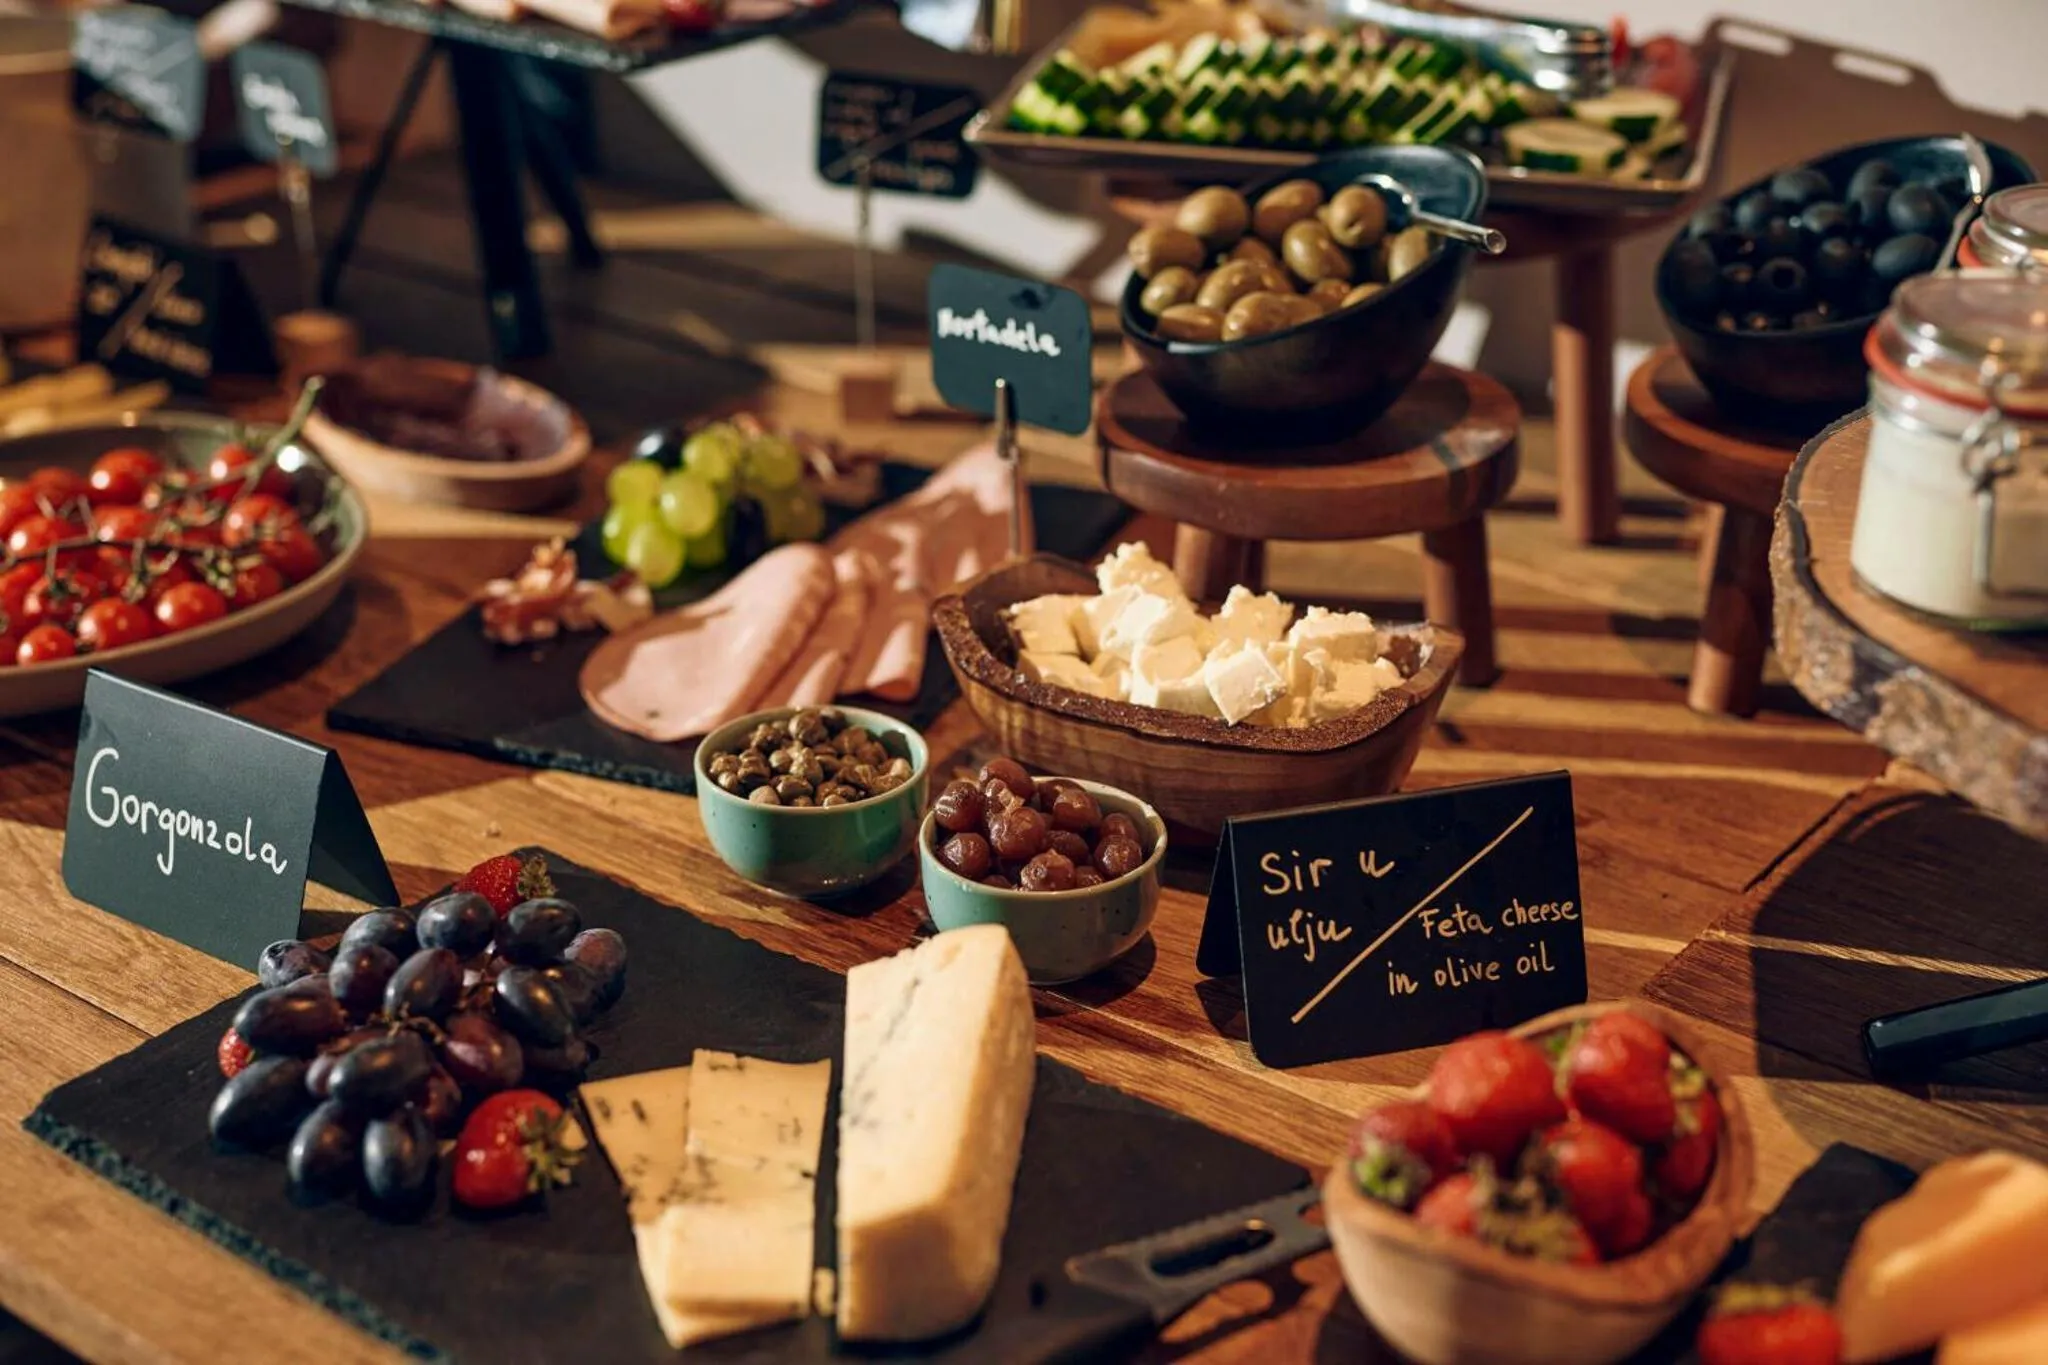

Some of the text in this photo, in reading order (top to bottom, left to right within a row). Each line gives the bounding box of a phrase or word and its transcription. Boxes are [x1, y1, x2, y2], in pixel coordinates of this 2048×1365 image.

[86, 747, 288, 875] Gorgonzola
[1260, 849, 1395, 895] Sir u
[1267, 909, 1352, 962] ulju
[1418, 898, 1580, 939] Feta cheese
[1387, 941, 1555, 996] in olive oil
